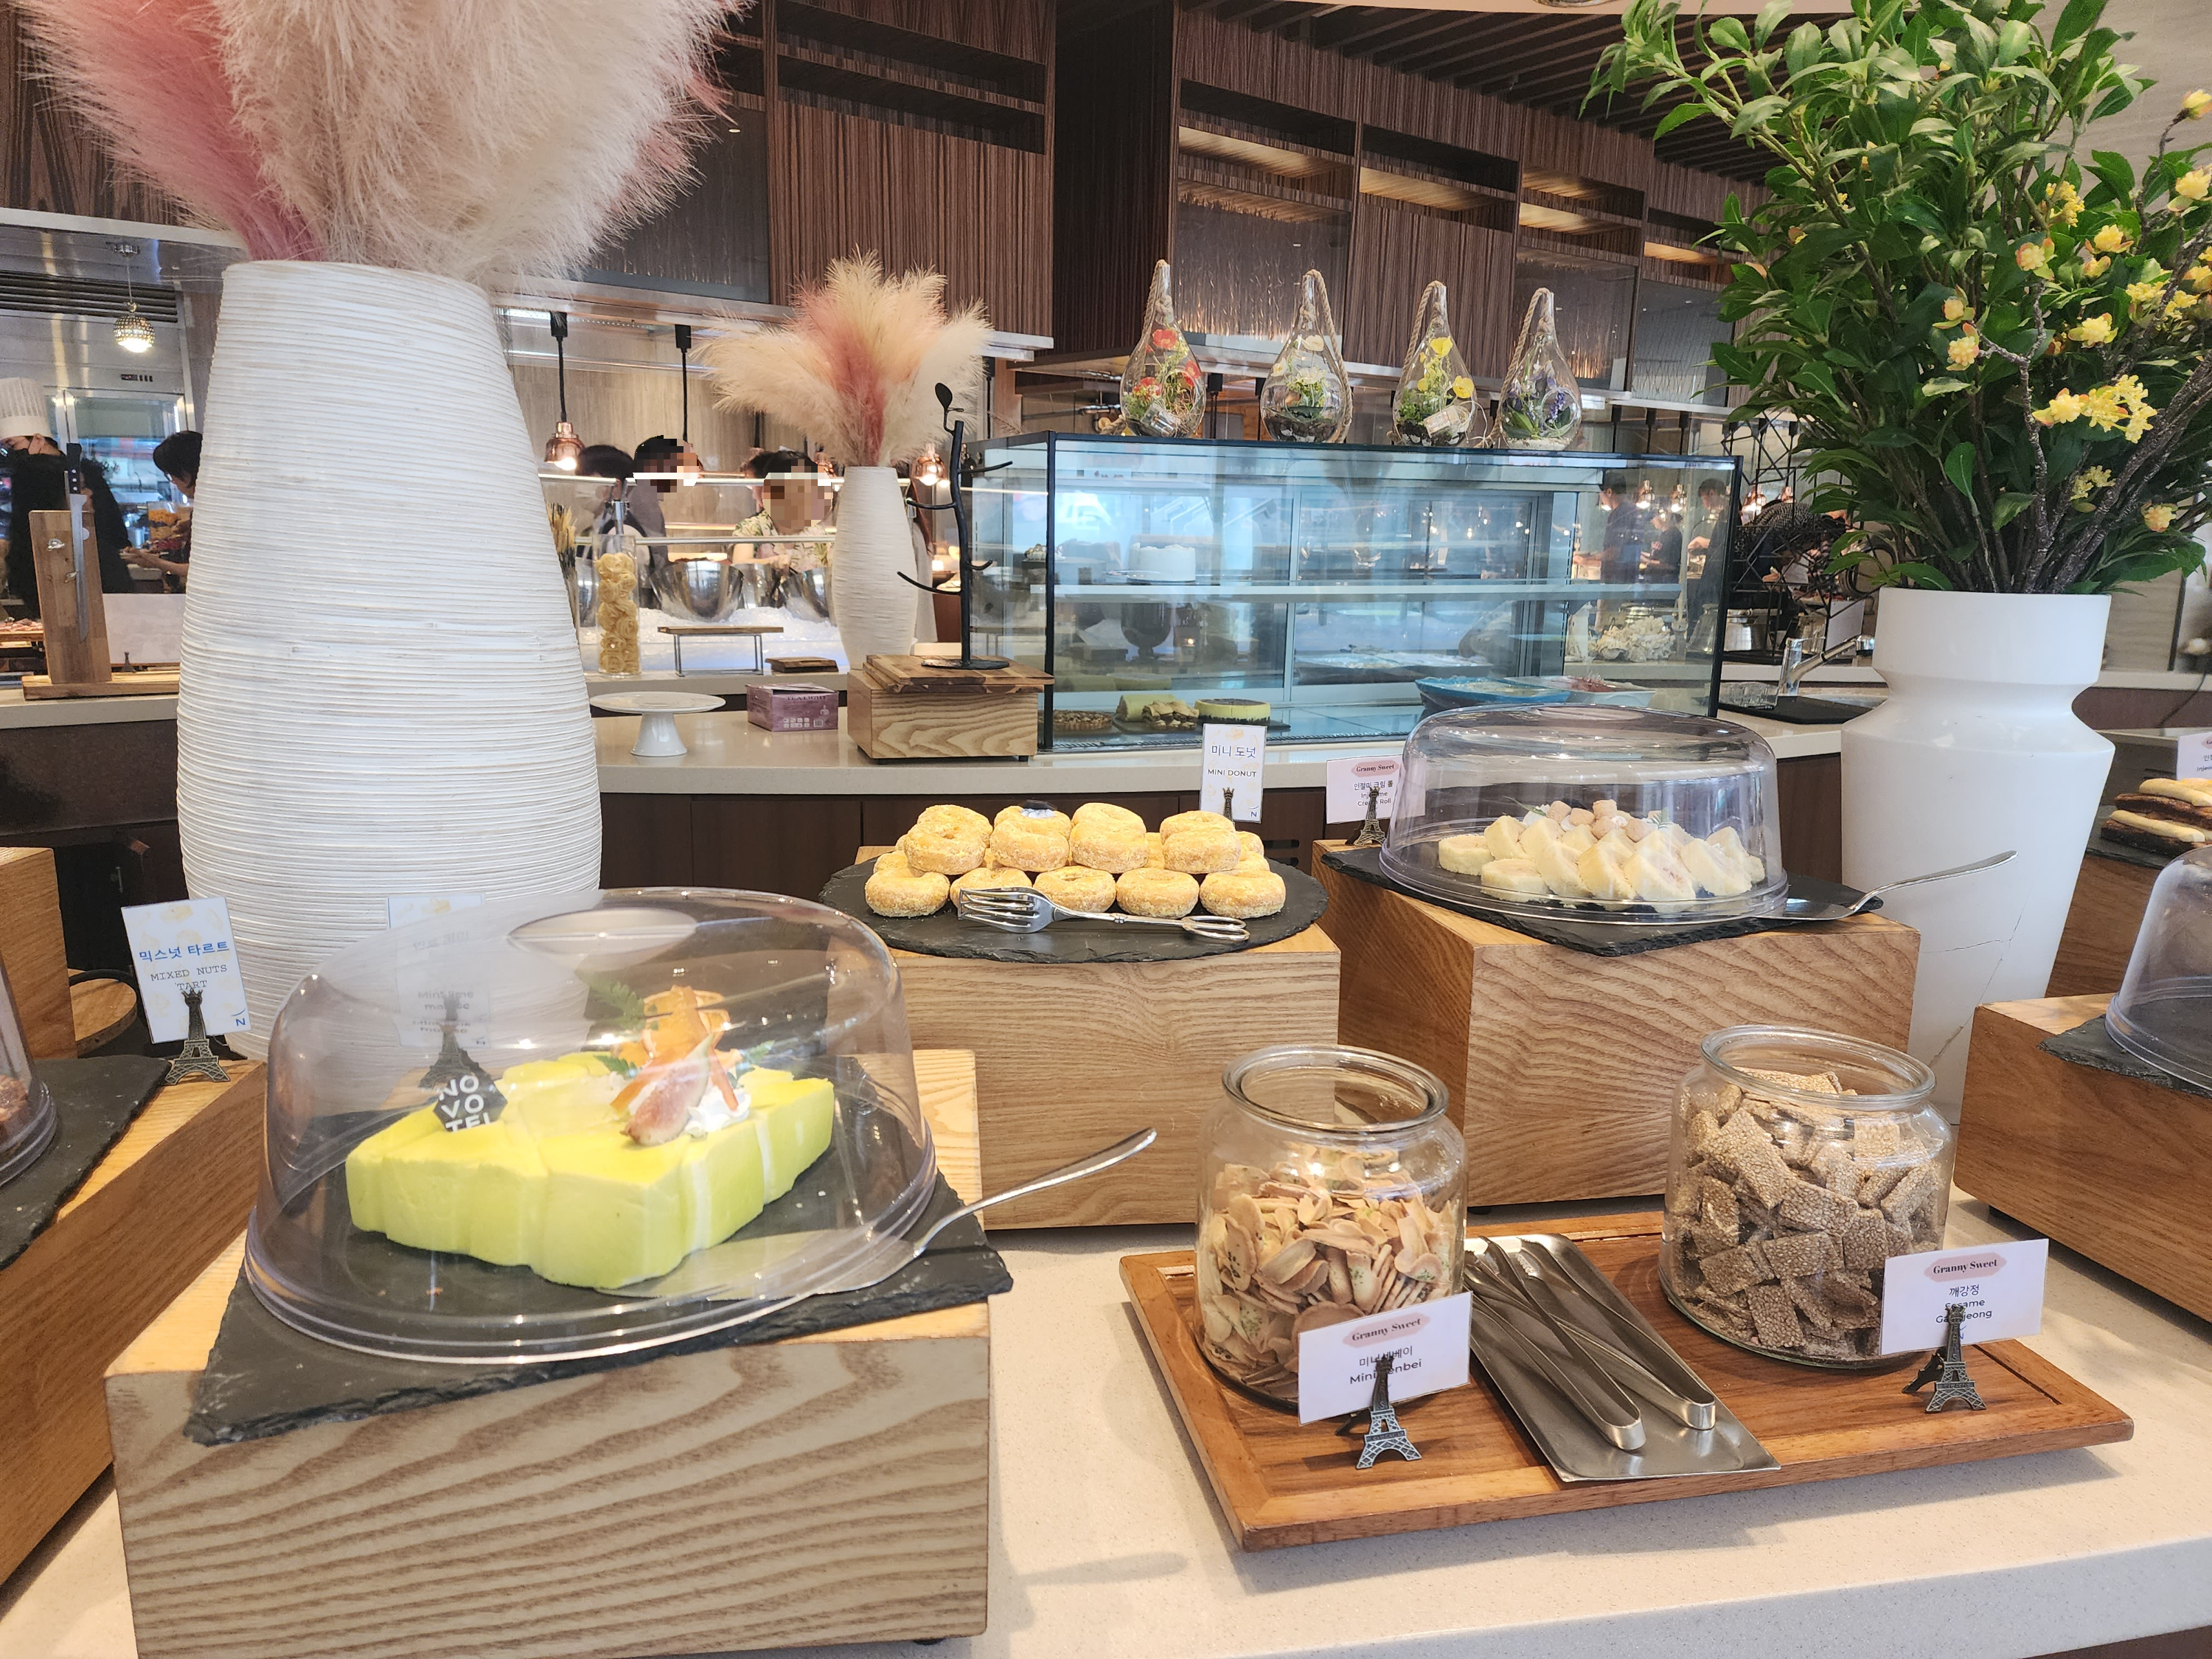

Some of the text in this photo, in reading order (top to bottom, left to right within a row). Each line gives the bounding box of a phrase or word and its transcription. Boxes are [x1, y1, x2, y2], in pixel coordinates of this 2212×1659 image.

[1211, 745, 1256, 759] 미니 도넛
[139, 941, 230, 962] 믹스넛 타르트
[150, 964, 227, 981] MIXED NUTS
[235, 1018, 246, 1026] N
[439, 1074, 479, 1101] NO
[441, 1094, 484, 1119] VO
[1933, 1259, 1997, 1274] Granny Sweet
[1949, 1284, 1980, 1298] 깨강정
[1935, 1310, 1992, 1324] Gajeong
[1352, 1318, 1421, 1341] Granny Sweet
[1350, 1358, 1422, 1385] Mini enbei
